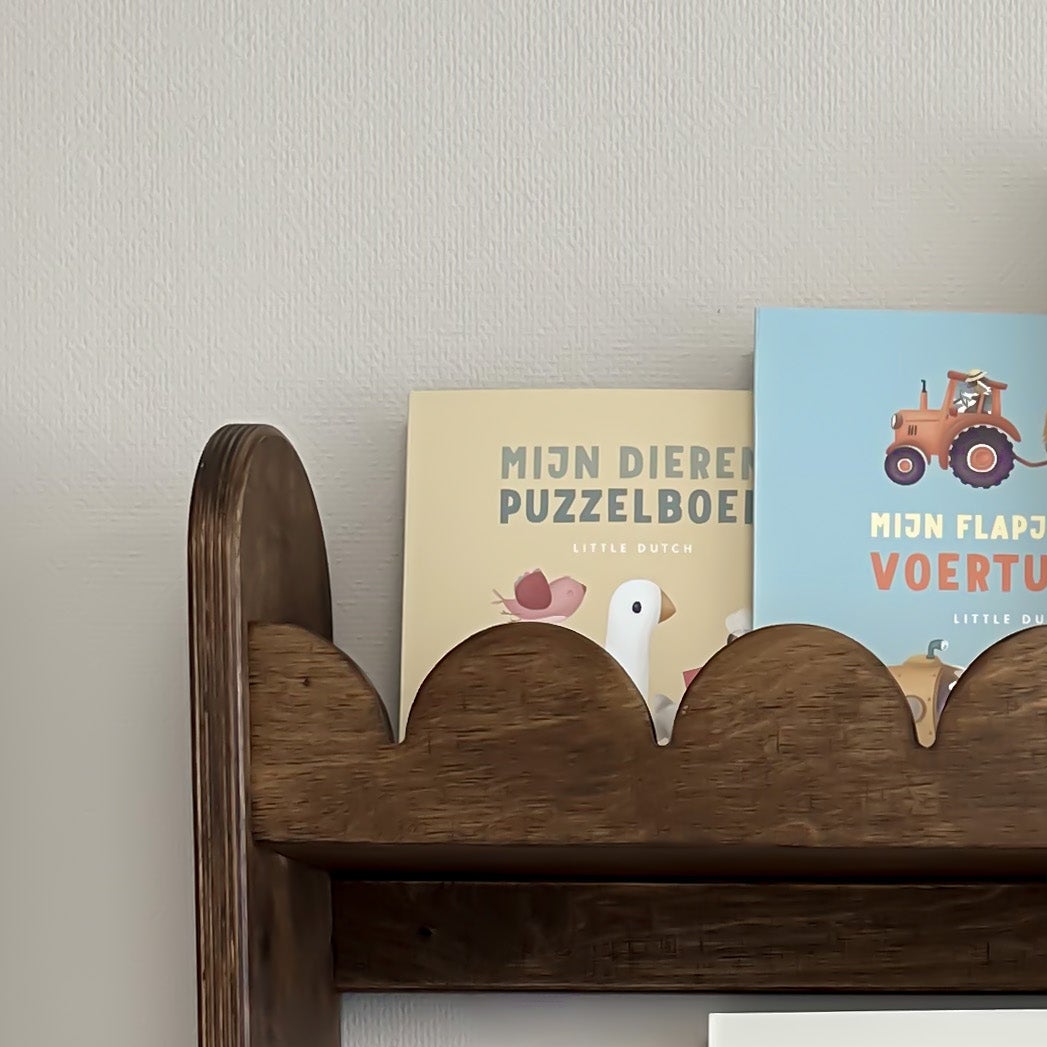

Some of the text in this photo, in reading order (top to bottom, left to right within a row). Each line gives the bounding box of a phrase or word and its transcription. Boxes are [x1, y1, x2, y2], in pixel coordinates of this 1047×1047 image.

[501, 445, 600, 480] MIJN
[870, 512, 944, 539] MIJN
[573, 543, 693, 553] LITTLE DUTCH
[953, 613, 1011, 625] LITTLE
